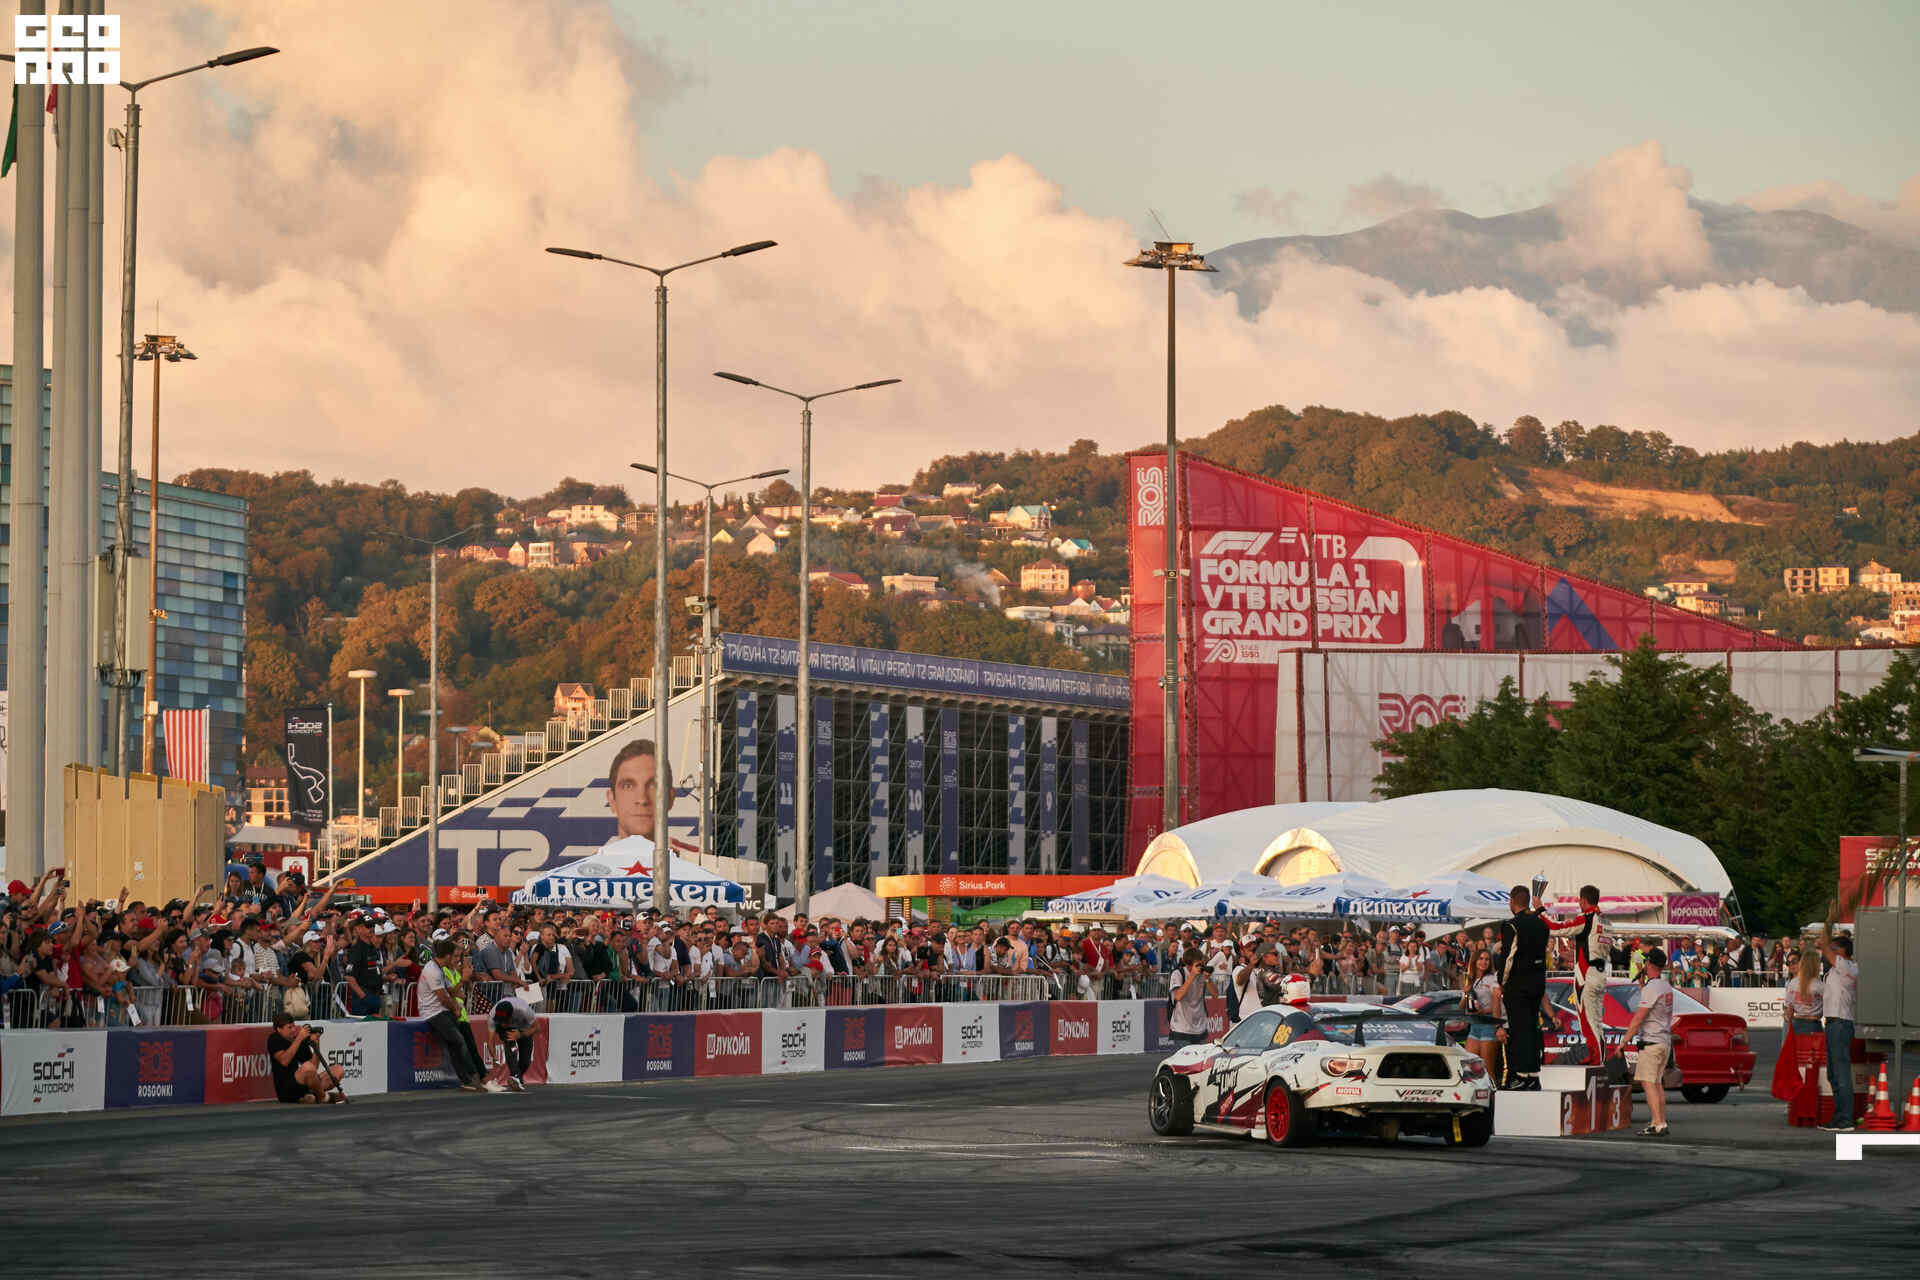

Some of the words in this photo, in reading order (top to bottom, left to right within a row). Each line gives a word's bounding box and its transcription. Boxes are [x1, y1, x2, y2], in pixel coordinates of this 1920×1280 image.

[1200, 558, 1350, 587] FORMULA
[1354, 563, 1371, 588] 1
[1200, 584, 1266, 610] VTB
[1270, 586, 1399, 615] RUSSIAN
[1202, 610, 1308, 637] GRAND
[1317, 612, 1383, 639] PRIX
[727, 643, 766, 664] ТРИБУНА
[820, 653, 856, 672] ПЕТРОВА
[862, 657, 887, 675] VITALY
[887, 659, 915, 678] PETROV
[928, 665, 975, 685] GRANDSTAND
[780, 783, 793, 805] 11
[908, 789, 922, 811] 10
[438, 829, 550, 887] T2
[549, 878, 727, 905] Heineken
[959, 880, 1006, 890] Sirius.Park
[740, 900, 761, 910] WC
[1672, 907, 1717, 917] МОРОЖЕНОЕ
[781, 1033, 806, 1048] SOCHI
[903, 1024, 933, 1046] ЛУКОЙЛ
[961, 1025, 983, 1039] SOCHI
[570, 1041, 600, 1057] SOCHI
[715, 1032, 751, 1056] ЛУКОЙЛ
[328, 1050, 363, 1066] SOCHI
[33, 1061, 74, 1081] SOCHI
[33, 1083, 74, 1094] AUTODROM
[137, 1084, 173, 1097] ROSGONKI
[1395, 1089, 1444, 1098] VIPER
[1586, 1076, 1596, 1130] 1
[1612, 1089, 1620, 1128] 3
[1563, 1094, 1572, 1136] 2
